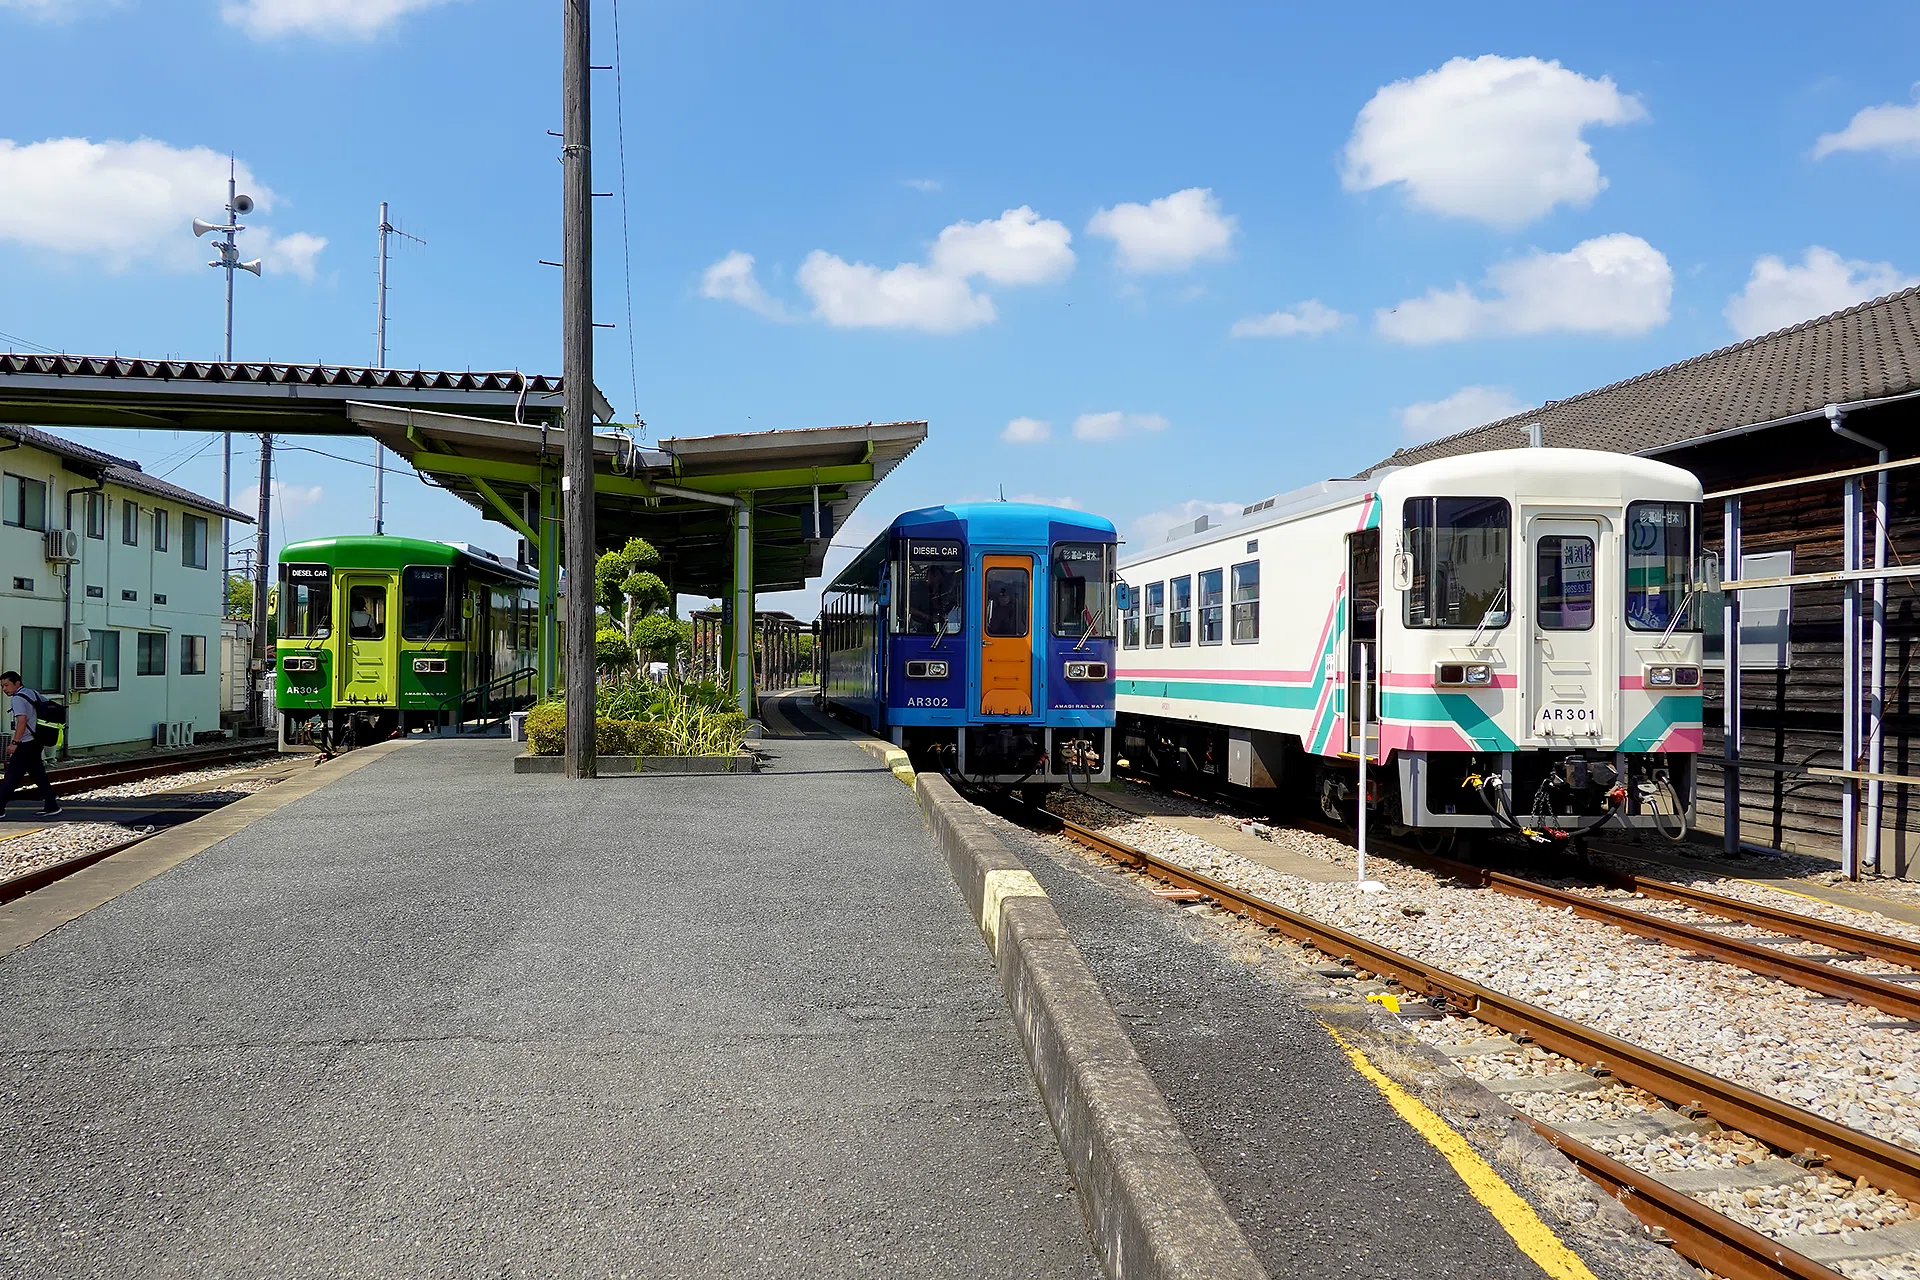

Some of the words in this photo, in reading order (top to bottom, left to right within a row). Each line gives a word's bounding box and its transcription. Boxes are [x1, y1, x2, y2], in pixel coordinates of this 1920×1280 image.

[913, 546, 939, 555] DIESEL
[941, 547, 958, 556] CAR
[292, 569, 313, 577] DIESEL
[286, 686, 319, 695] AR304
[907, 697, 948, 707] AR302
[1542, 709, 1594, 720] AR301
